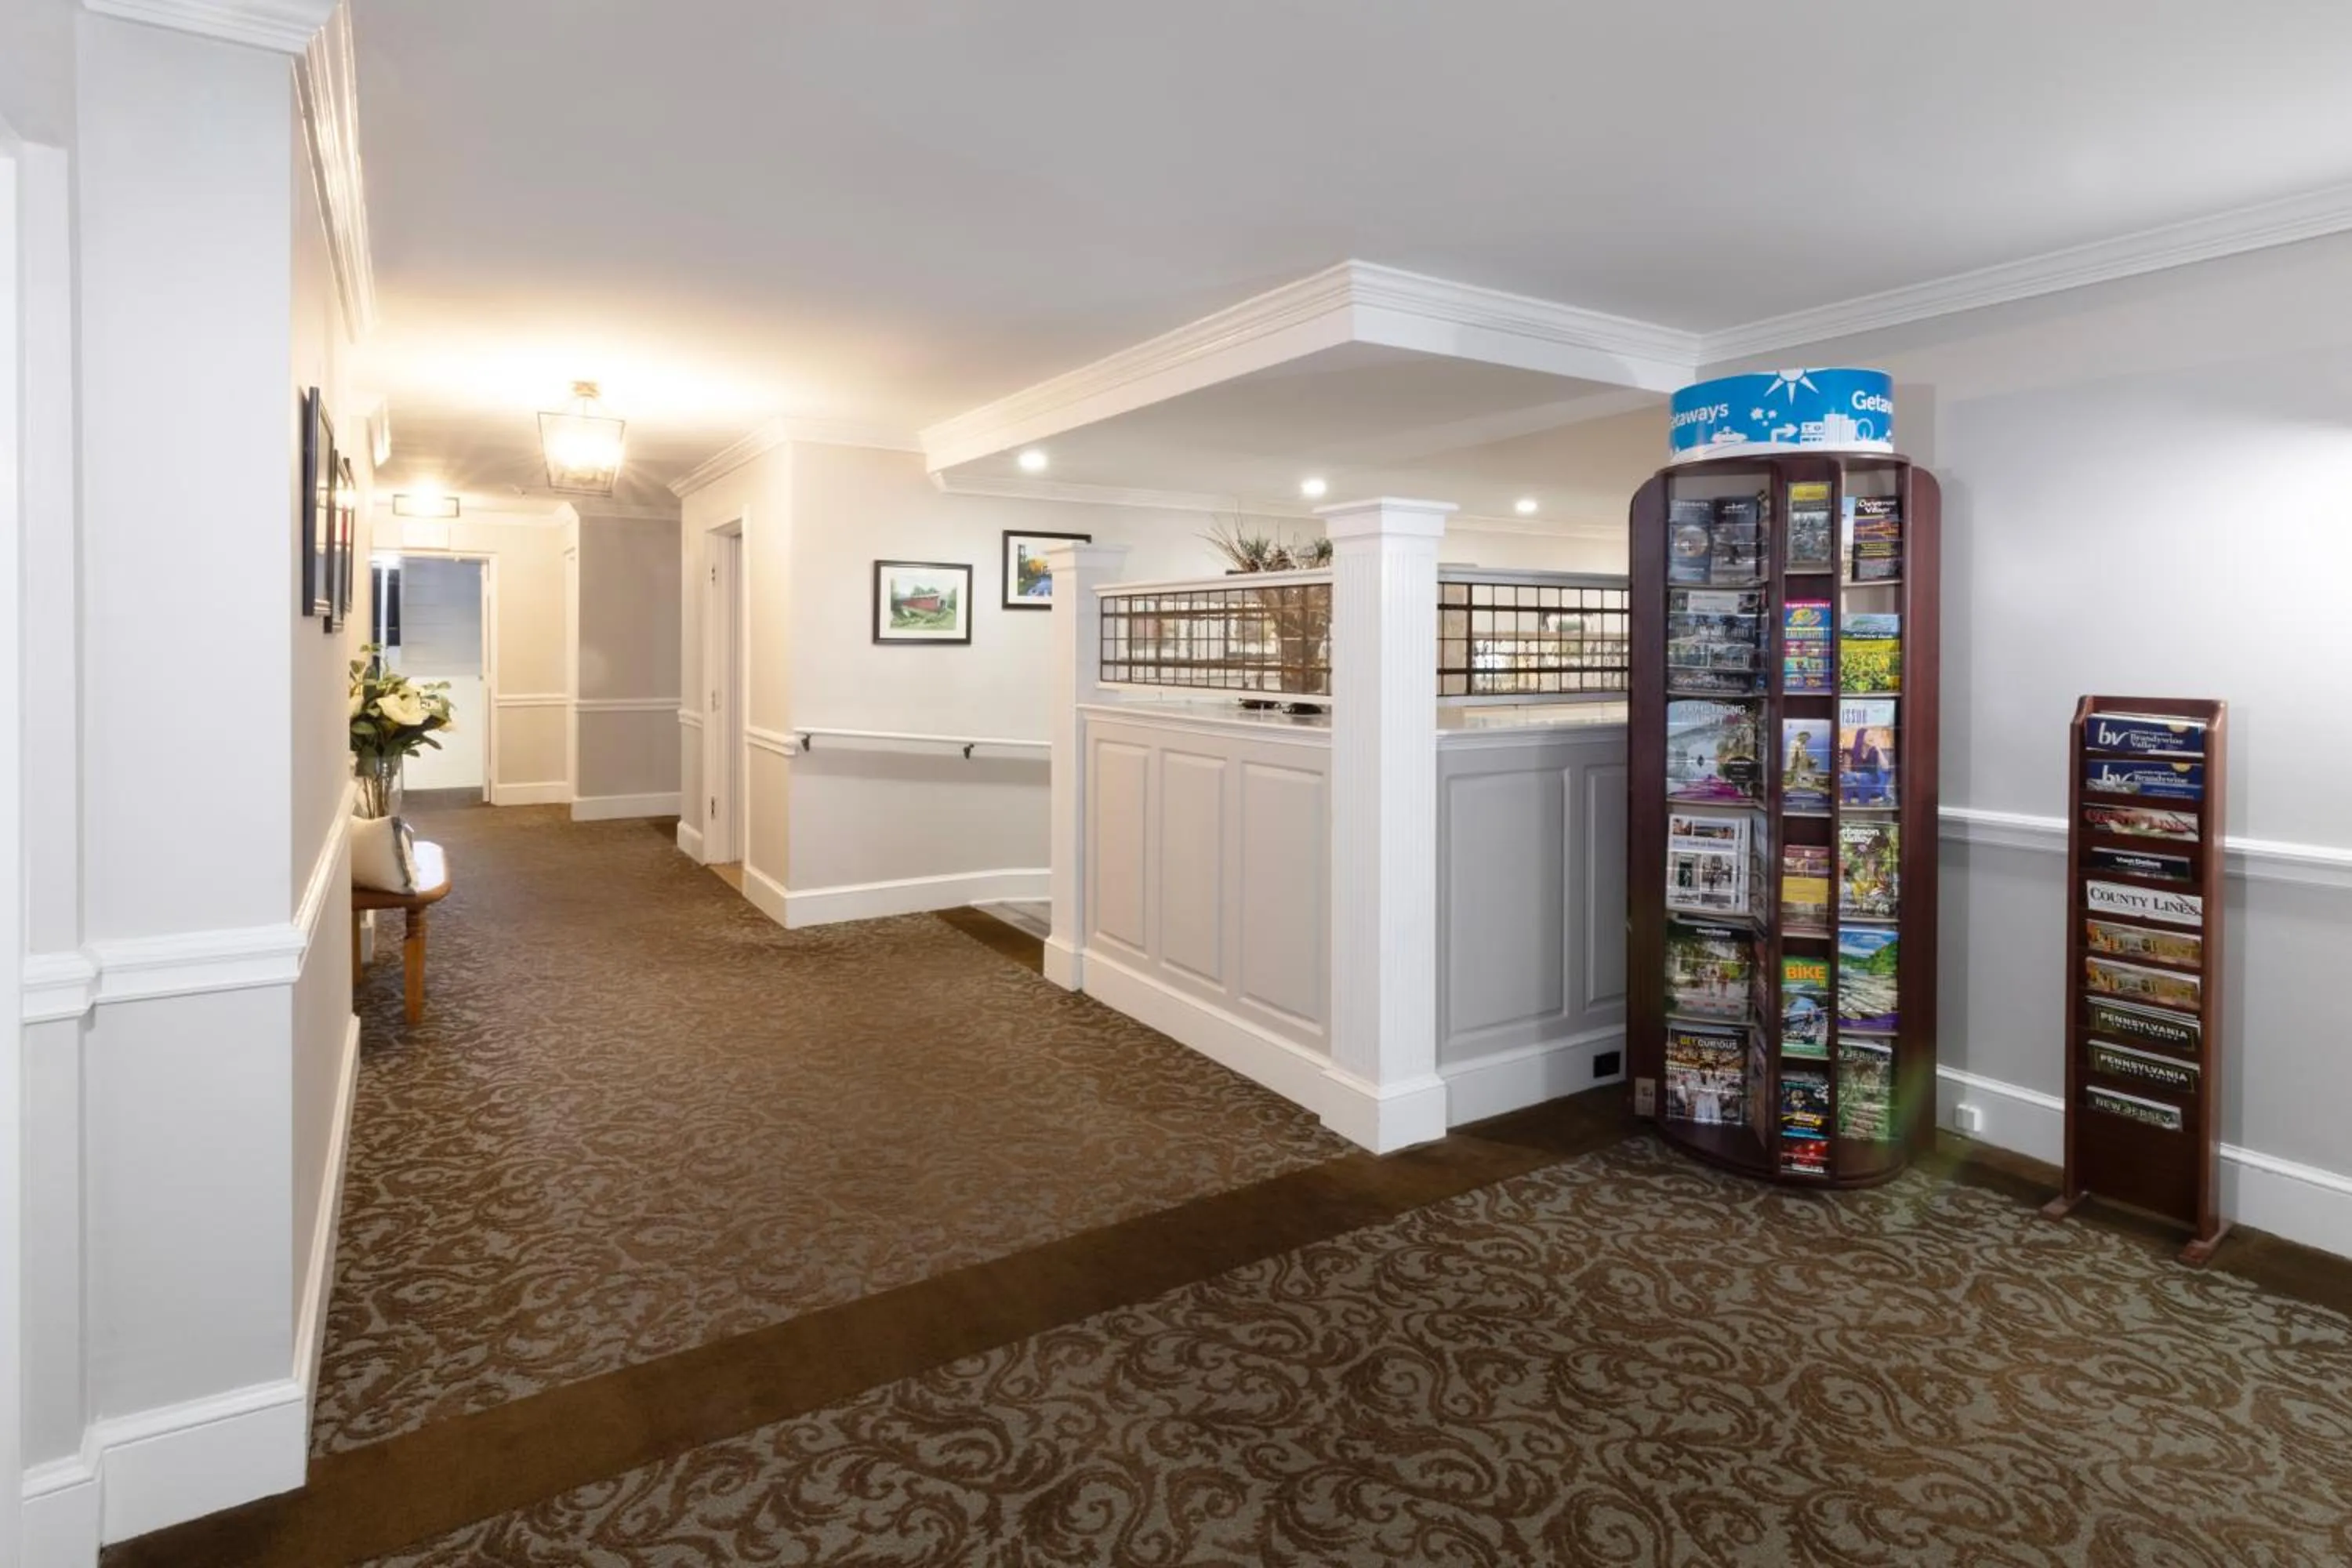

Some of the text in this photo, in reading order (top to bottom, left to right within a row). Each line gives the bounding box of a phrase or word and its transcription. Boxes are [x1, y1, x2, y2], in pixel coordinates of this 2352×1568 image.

[2130, 733, 2184, 746] Brandywine
[2089, 887, 2199, 916] COUNTY LINES
[1785, 964, 1827, 979] BIKE
[2100, 1011, 2189, 1040] PENNSYLVANIA
[1697, 1038, 1738, 1050] CURIOUS
[2100, 1054, 2188, 1083] PENNSYLVANIA
[2095, 1097, 2122, 1112] NEW
